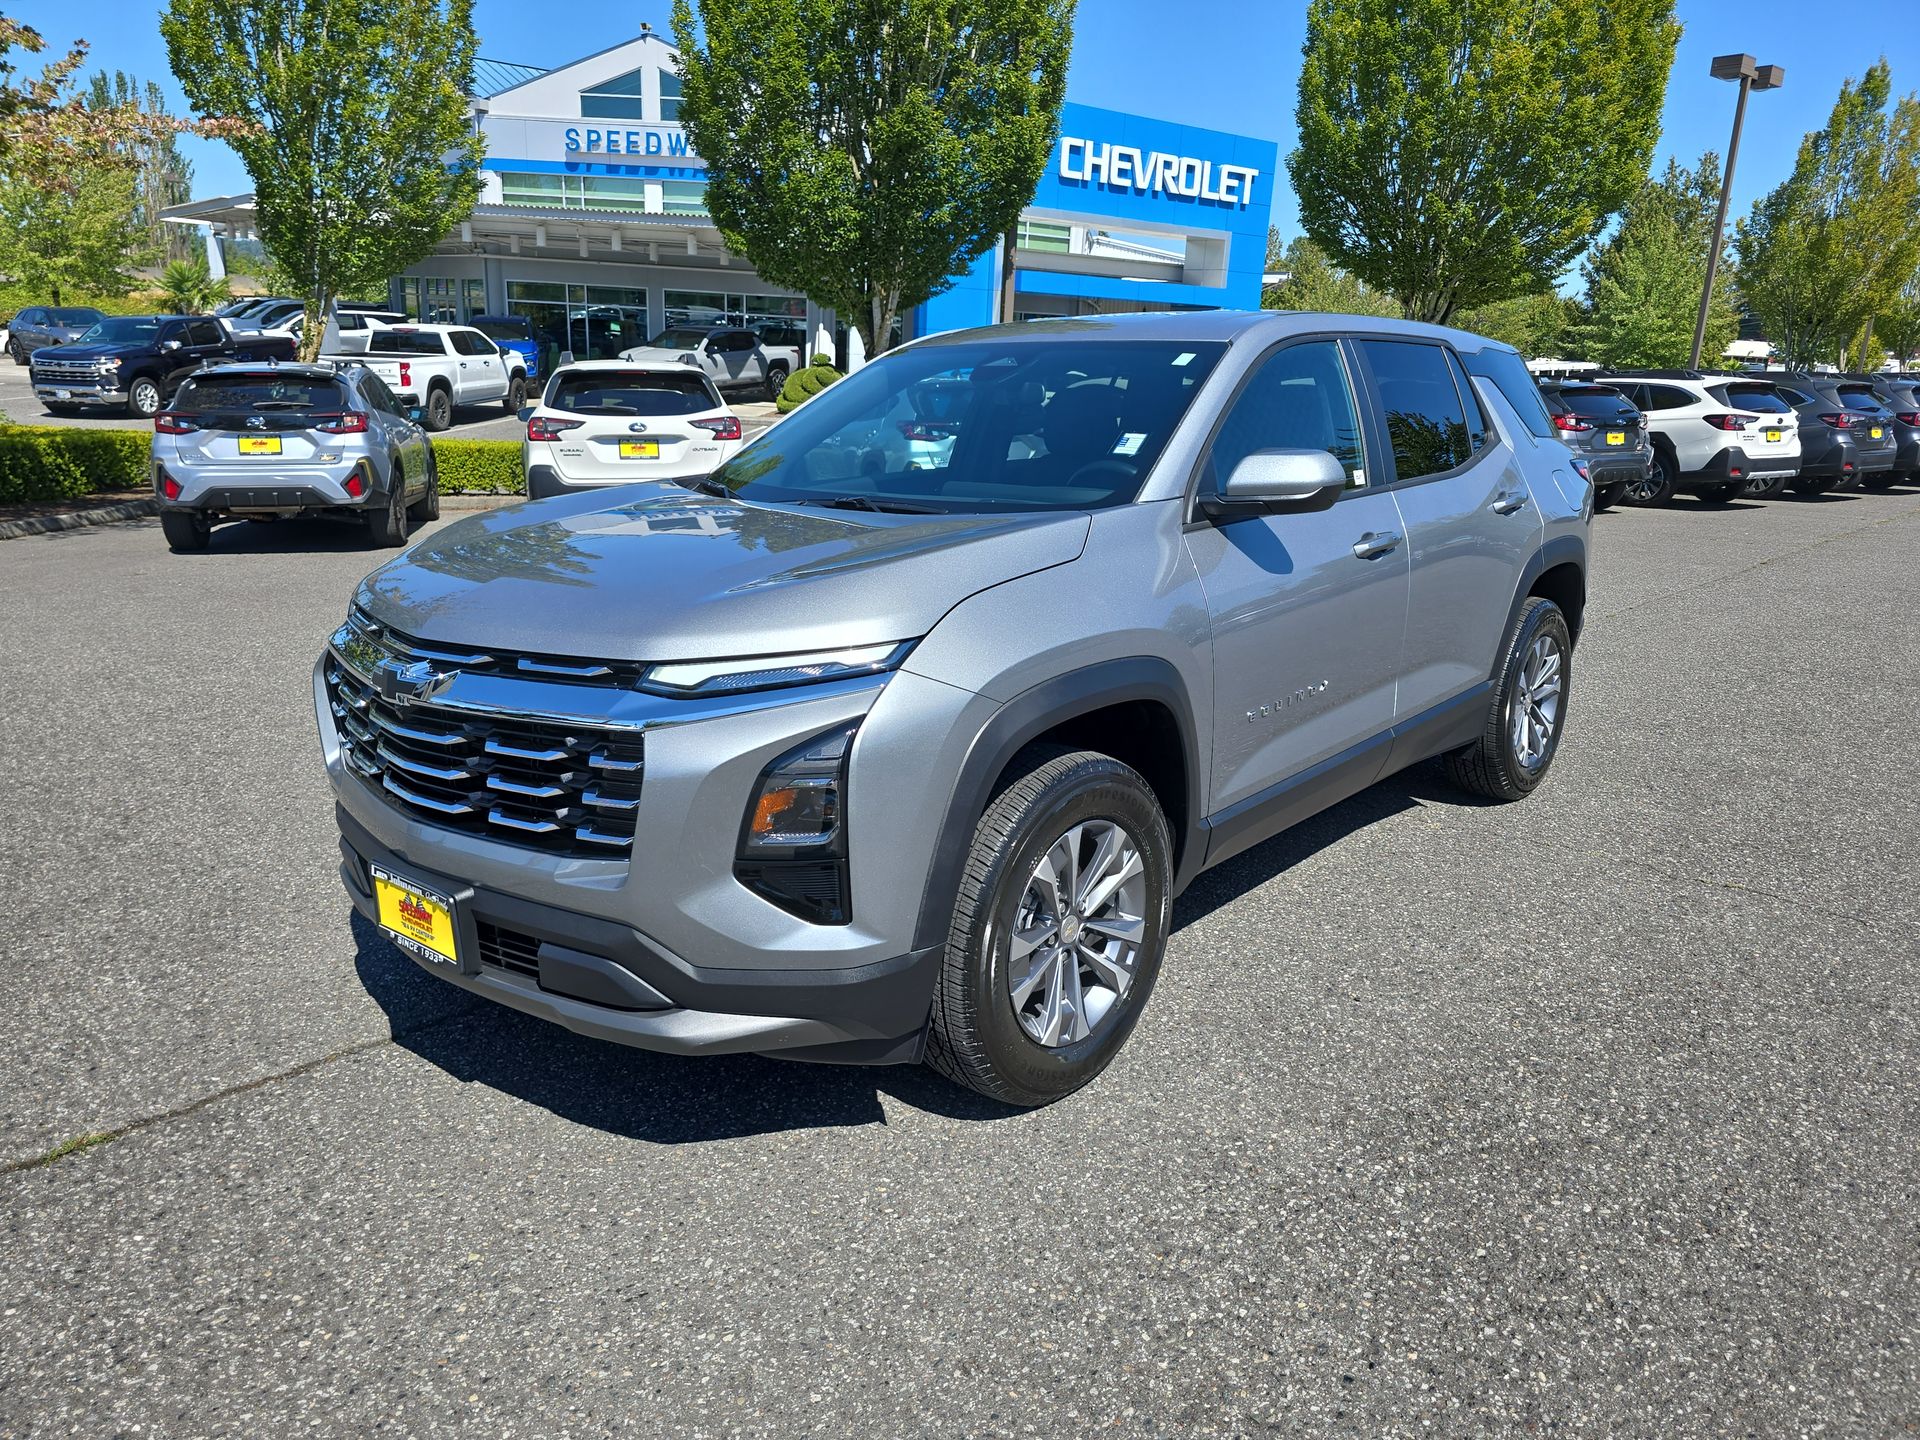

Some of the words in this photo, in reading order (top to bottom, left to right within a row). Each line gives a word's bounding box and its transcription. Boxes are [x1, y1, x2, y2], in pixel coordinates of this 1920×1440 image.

[565, 127, 688, 157] SPEEDW
[1059, 136, 1259, 204] CHEVROLET
[397, 936, 418, 952] SINCE
[421, 947, 439, 963] 1933
